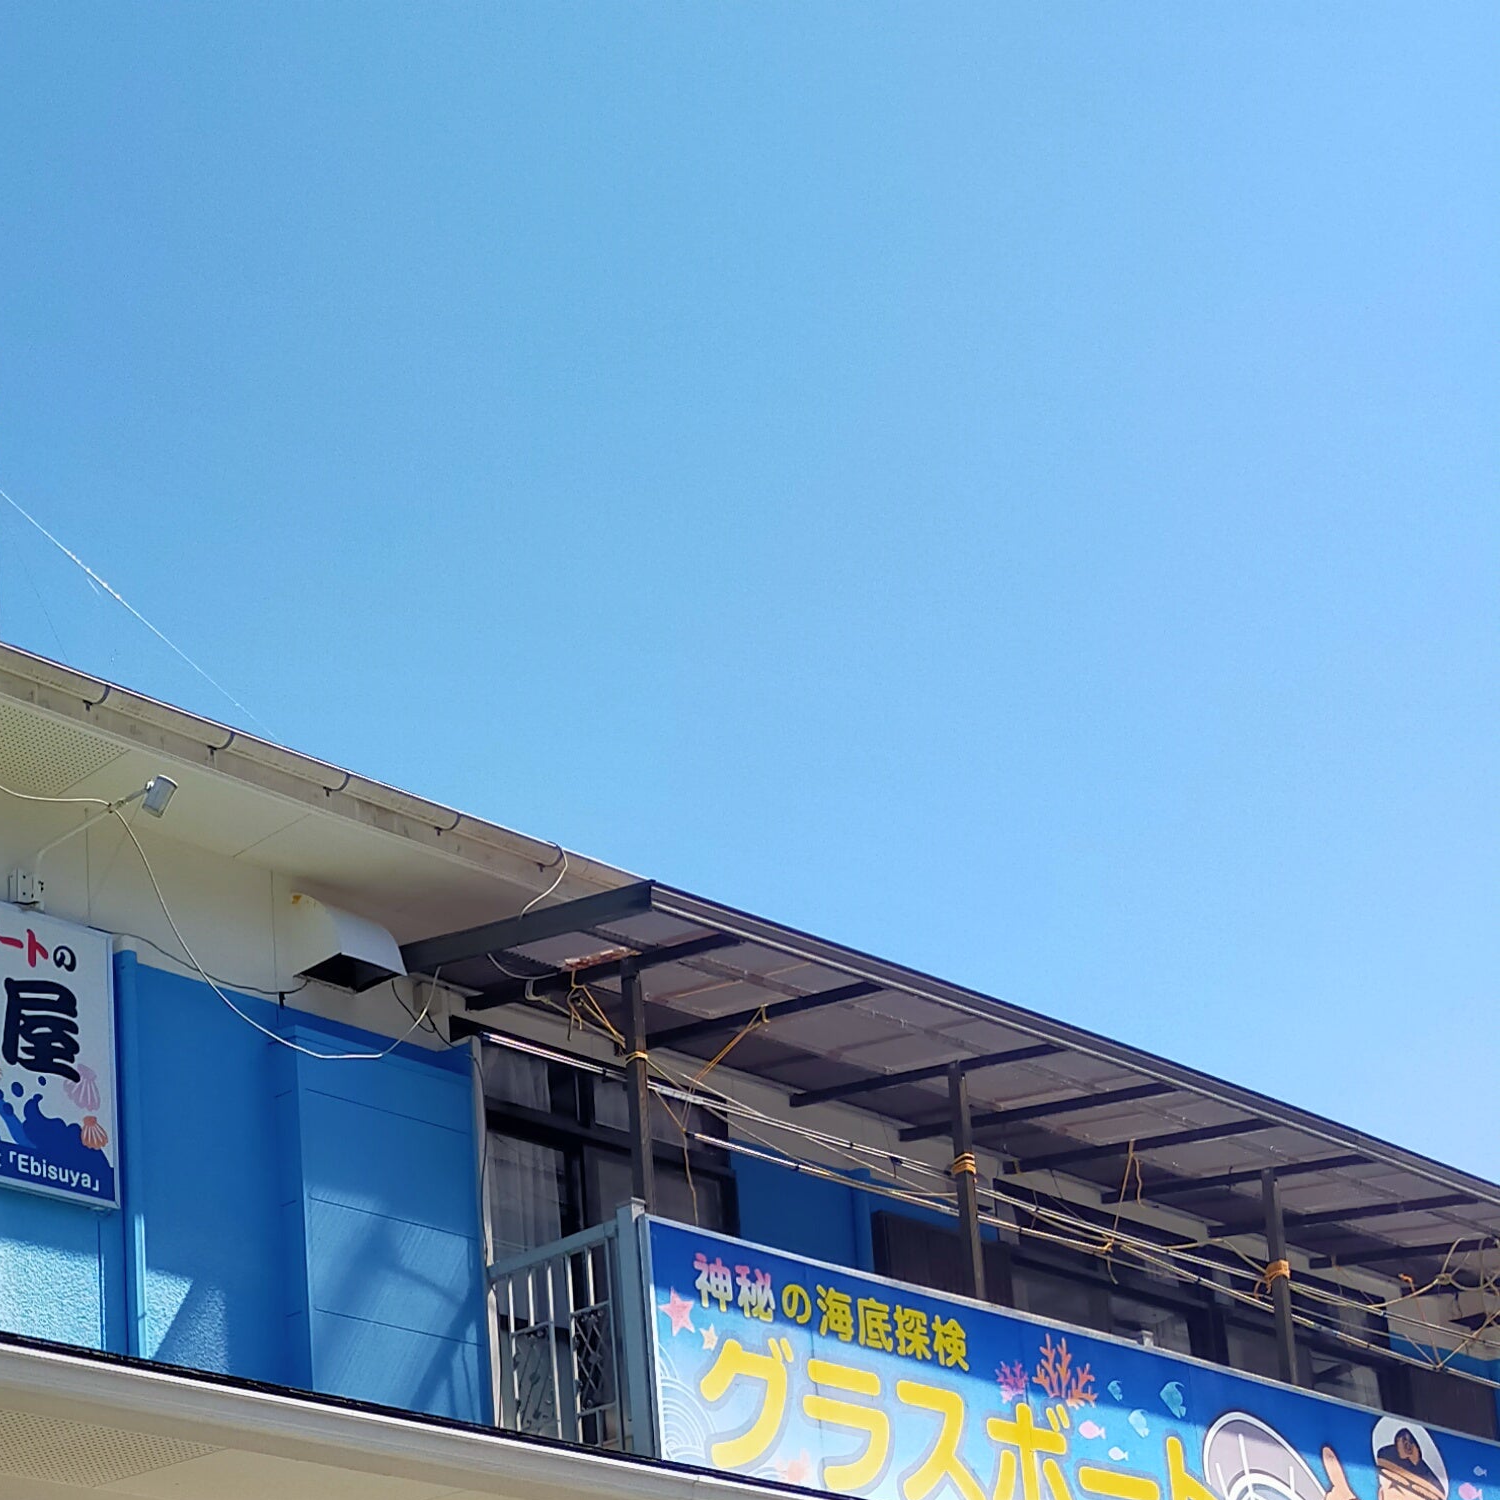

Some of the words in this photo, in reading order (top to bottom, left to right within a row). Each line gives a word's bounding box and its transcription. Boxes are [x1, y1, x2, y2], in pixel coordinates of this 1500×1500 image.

[692, 1253, 970, 1371] 神秘の海底探検
